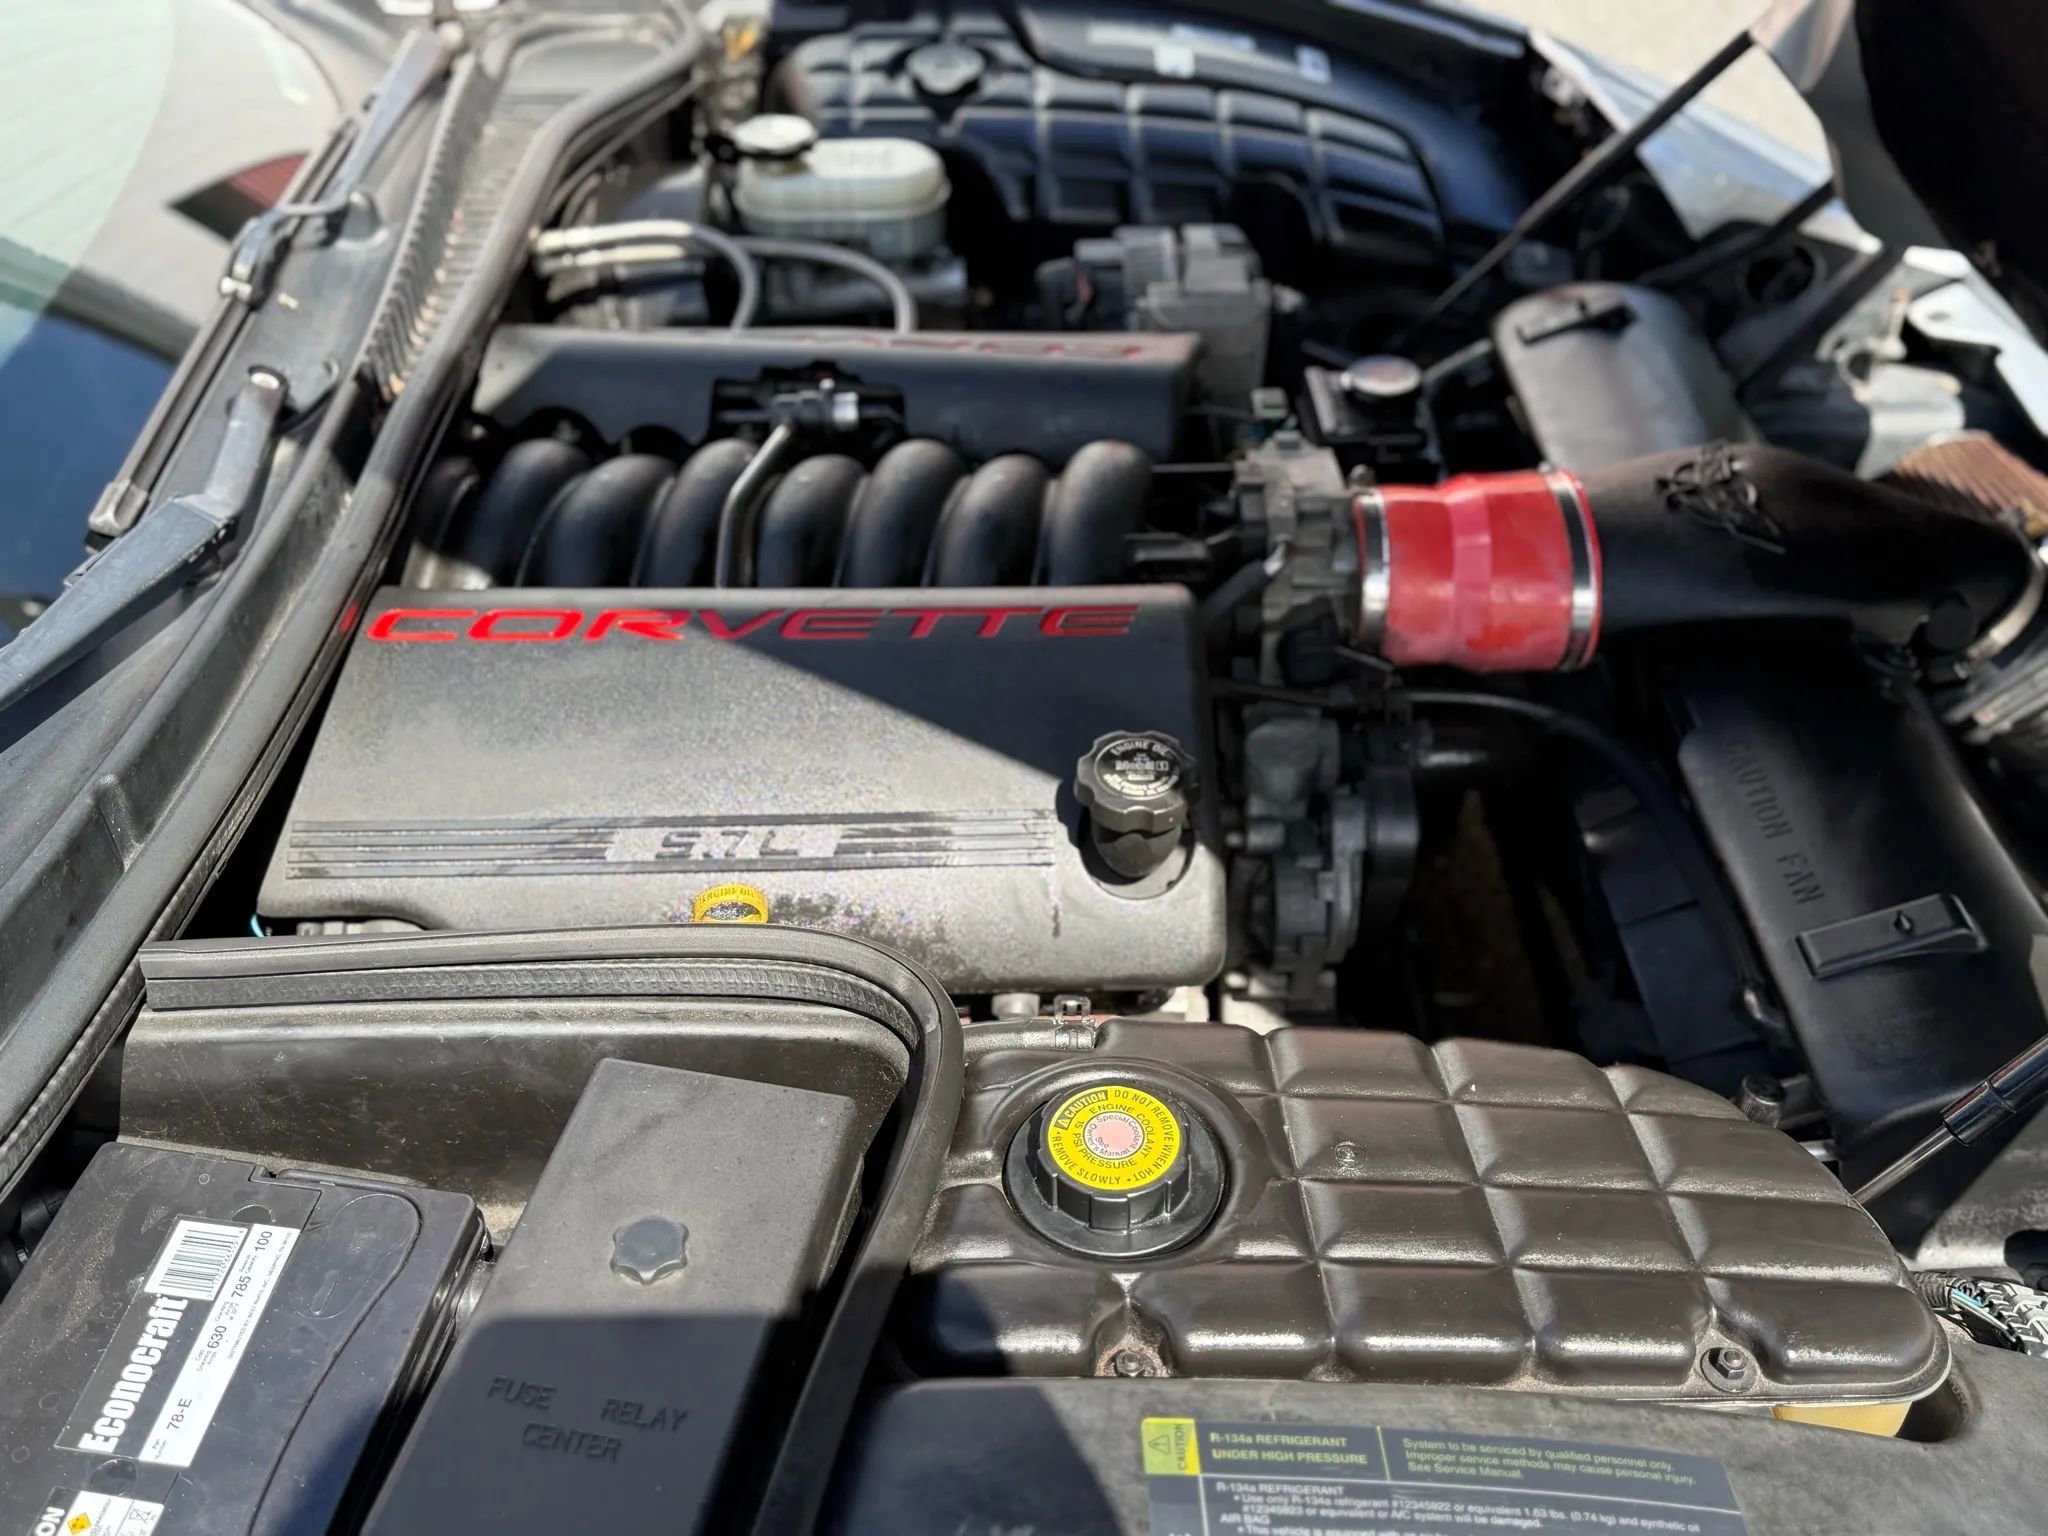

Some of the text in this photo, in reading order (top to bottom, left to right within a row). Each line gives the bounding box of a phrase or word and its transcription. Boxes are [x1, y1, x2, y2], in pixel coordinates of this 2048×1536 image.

[366, 604, 1140, 642] CORVETTE
[1110, 741, 1148, 756] ENGINE
[1152, 743, 1169, 757] OIL
[655, 830, 801, 857] 5.7L
[1776, 852, 1825, 904] FAN
[1065, 1089, 1174, 1182] CAUTION DO NOT REMOVE WHEN HOT
[1089, 1103, 1155, 1159] ENGINE COOLANT
[1096, 1113, 1142, 1150] Special Coolant
[1052, 1136, 1121, 1185] REMOVE SLOWLY
[1073, 1132, 1083, 1150] PSI
[1078, 1147, 1137, 1169] PRESSURE
[1100, 1148, 1131, 1157] Manual
[254, 1231, 273, 1252] 100
[231, 1276, 252, 1298] 785
[207, 1325, 227, 1349] 630
[78, 1295, 188, 1453] Econocraft
[166, 1397, 193, 1431] 78-E
[487, 1375, 689, 1434] FUSE RELAY
[522, 1422, 623, 1463] CENTER
[1174, 1422, 1188, 1471] CAUTION
[1210, 1432, 1347, 1447] R-134a REFRIGERANT
[1402, 1437, 1446, 1450] System
[1447, 1441, 1459, 1451] to
[1461, 1442, 1477, 1452] be
[1480, 1444, 1526, 1456] serviced
[1528, 1447, 1542, 1459] by
[1545, 1449, 1591, 1461] qualified
[1593, 1454, 1647, 1468] personnel
[1212, 1448, 1368, 1465] UNDER HIGH PRESSURE
[1405, 1450, 1456, 1463] Improper
[1459, 1454, 1499, 1465] service
[1502, 1456, 1551, 1469] methods
[1553, 1461, 1577, 1474] may
[1580, 1463, 1613, 1475] cause
[1615, 1466, 1662, 1480] personal
[1408, 1461, 1432, 1472] See
[1434, 1462, 1477, 1475] Service
[1216, 1481, 1345, 1496] R-134a REFRIGERANT
[1220, 1513, 1271, 1525] AIR BAG
[1241, 1493, 1264, 1504] Use
[1266, 1494, 1289, 1506] only
[1618, 1516, 1639, 1527] and
